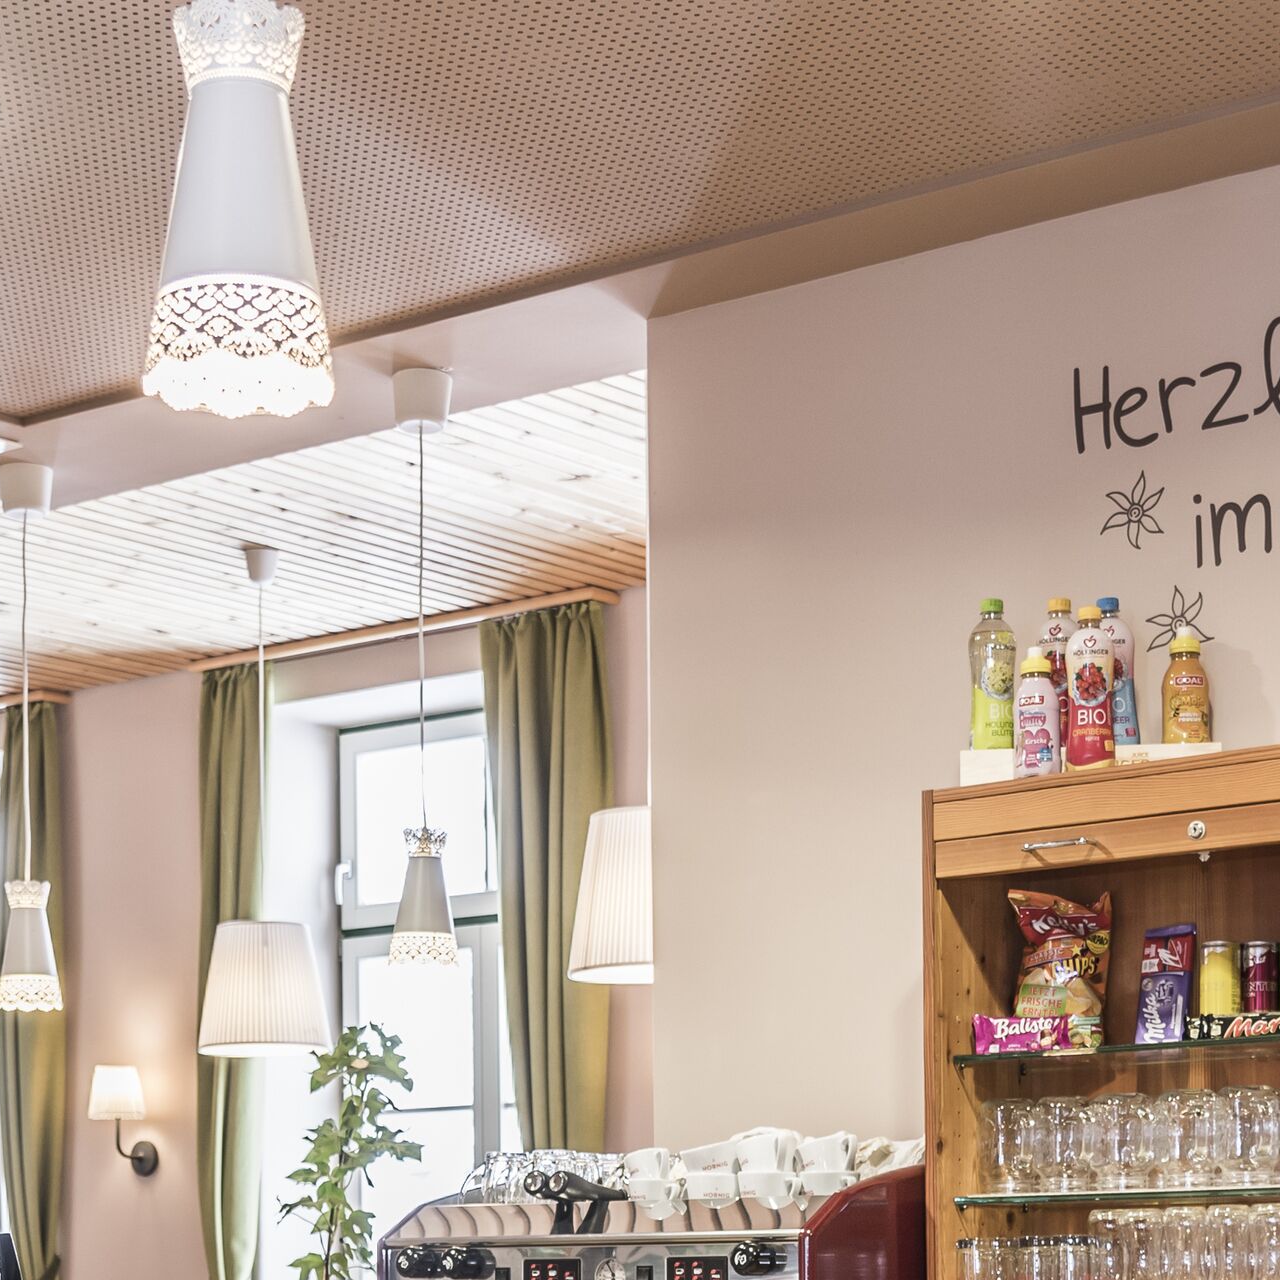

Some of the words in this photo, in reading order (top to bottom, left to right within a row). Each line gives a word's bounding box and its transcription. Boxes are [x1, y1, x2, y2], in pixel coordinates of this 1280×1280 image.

[1191, 491, 1274, 570] im
[1077, 708, 1107, 726] BIO
[1142, 992, 1166, 1044] Milka
